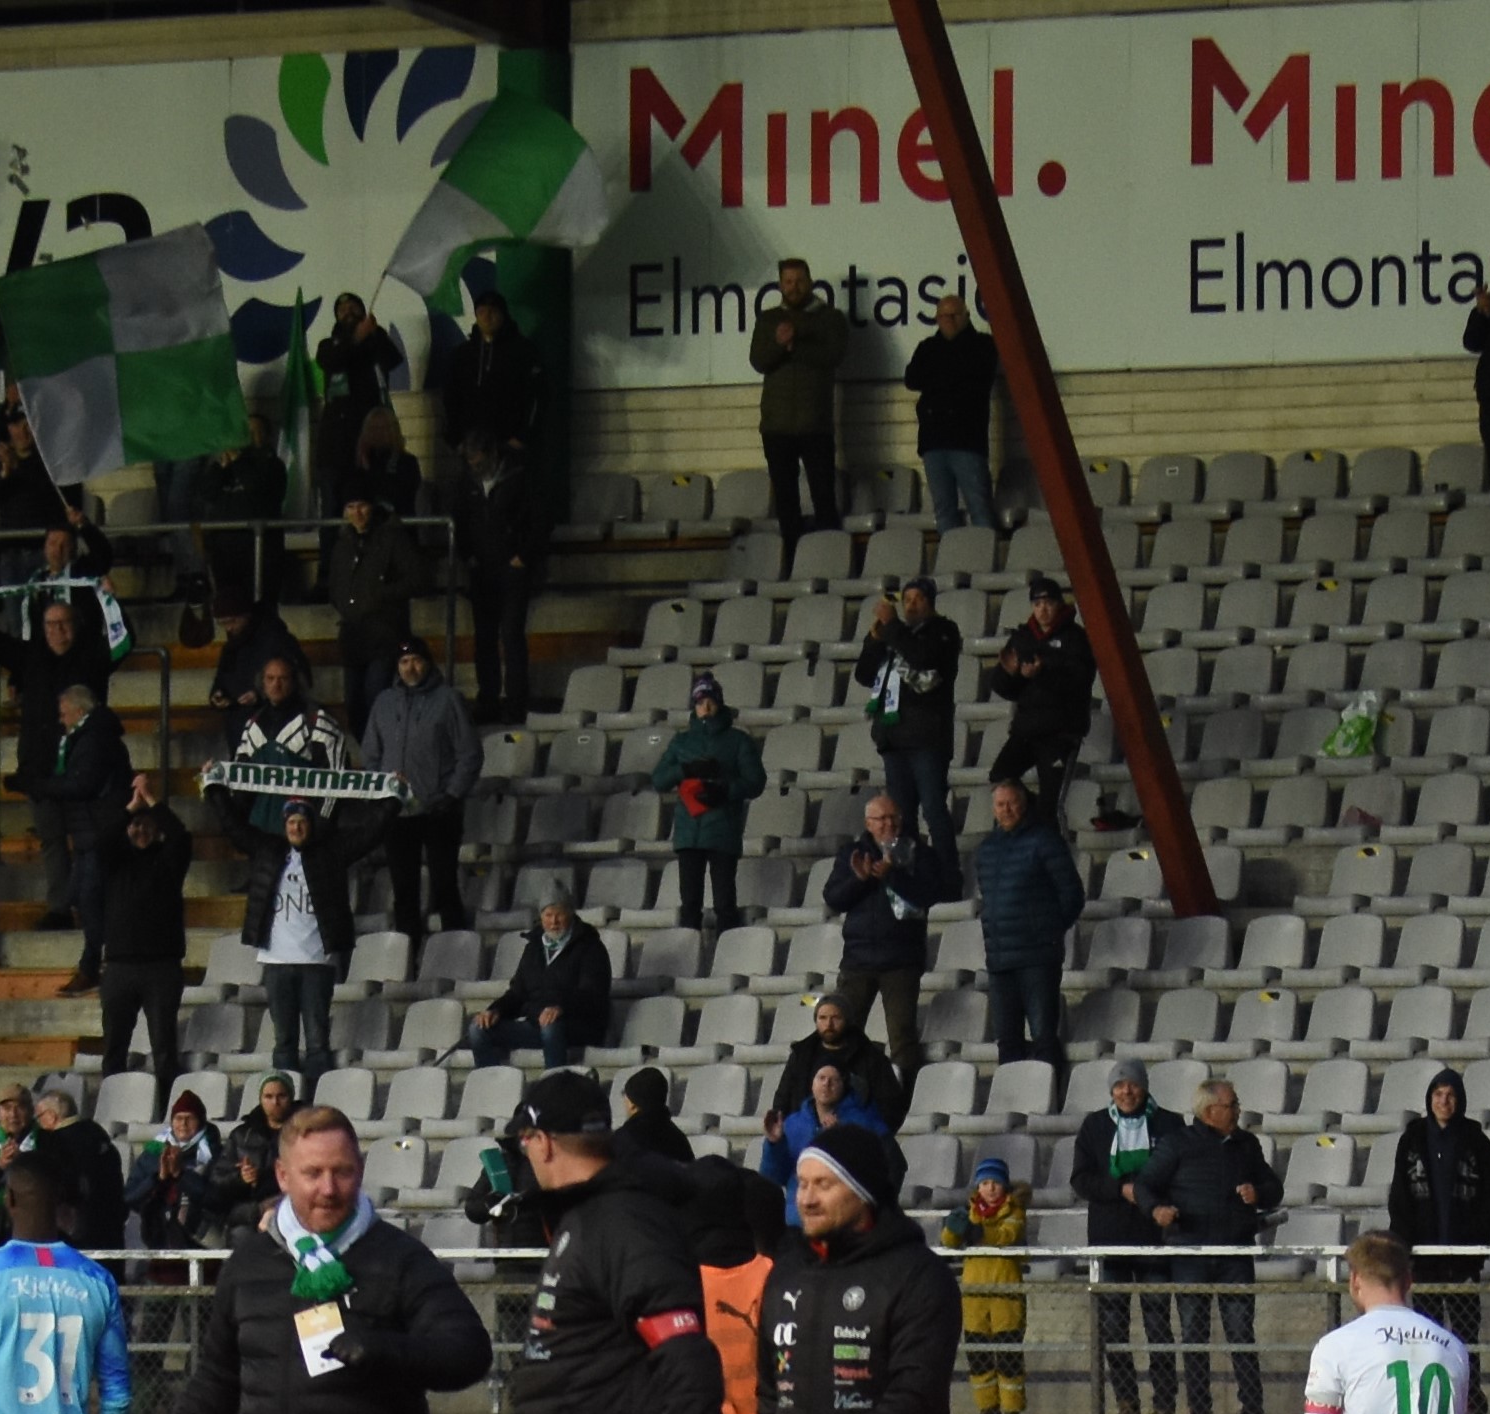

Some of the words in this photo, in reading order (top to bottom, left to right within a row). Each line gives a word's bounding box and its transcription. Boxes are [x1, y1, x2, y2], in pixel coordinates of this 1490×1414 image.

[629, 254, 991, 337] Elmtasi
[19, 1312, 84, 1405] 31
[1375, 1326, 1451, 1348] Kjelstad
